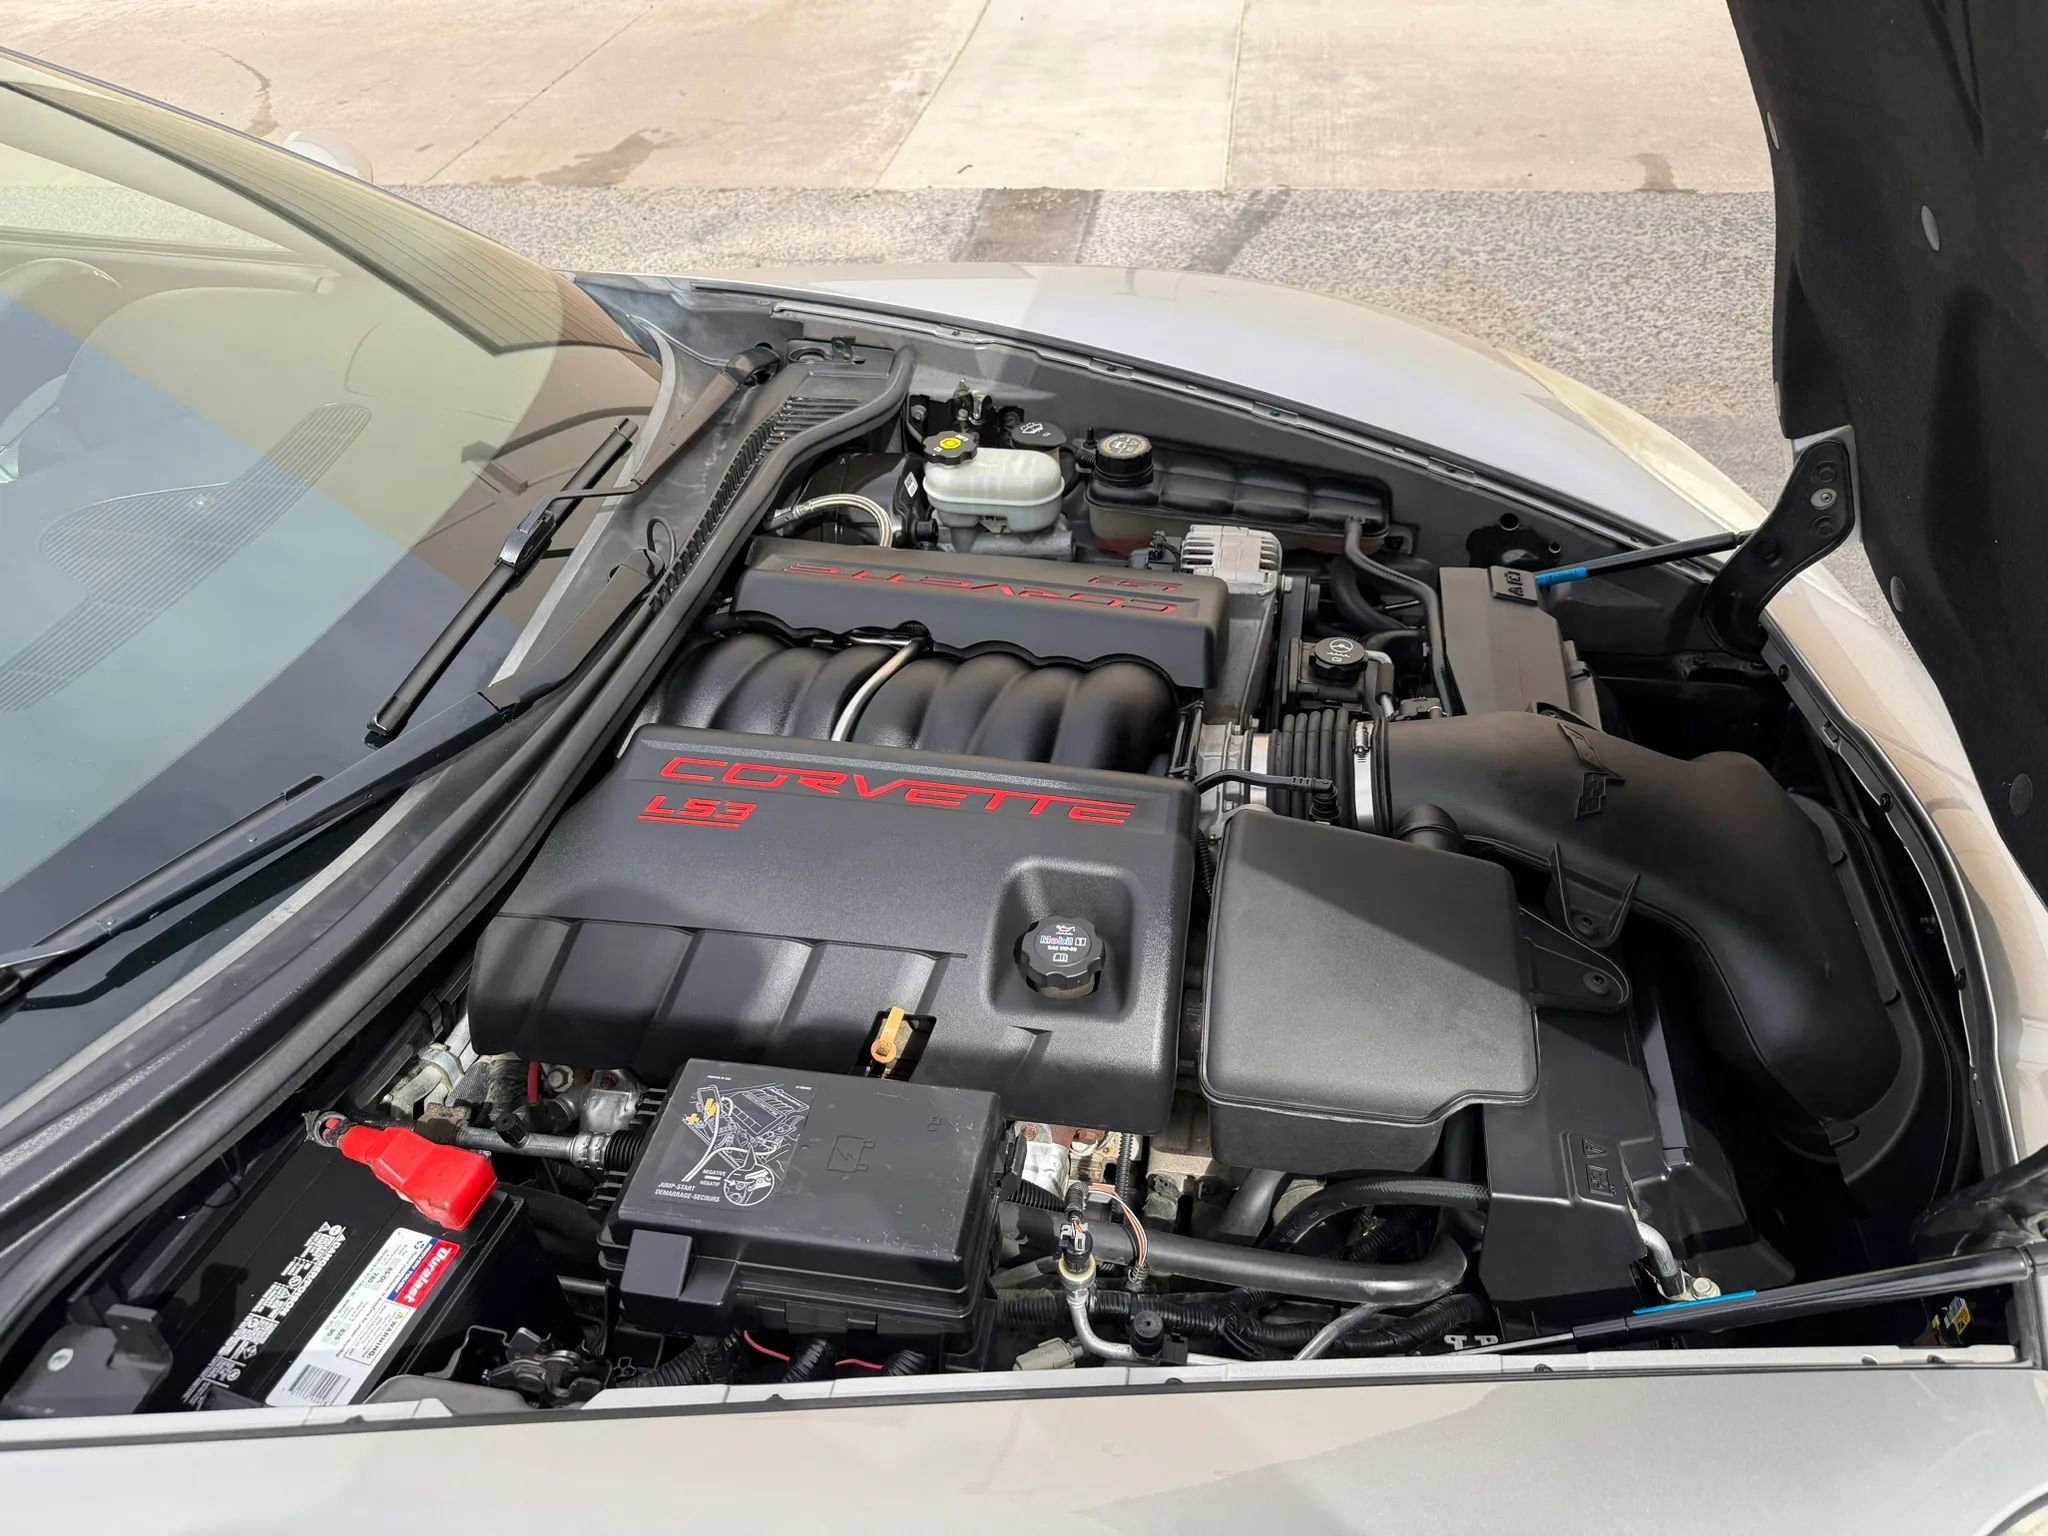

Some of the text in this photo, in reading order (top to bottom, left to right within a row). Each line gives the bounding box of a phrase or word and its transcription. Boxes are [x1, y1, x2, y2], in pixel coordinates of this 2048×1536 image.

[784, 563, 1179, 615] CORVETTE
[660, 756, 1137, 825] CORVETTE
[643, 795, 757, 822] LS3
[1040, 935, 1073, 946] Mobil
[658, 1182, 696, 1191] JUMP-START
[409, 1242, 433, 1270] PROVEN
[278, 1239, 342, 1317] DANGER/POISON
[393, 1270, 413, 1293] TOUGH
[402, 1247, 452, 1304] Duralast
[365, 1319, 398, 1360] WARNING:
